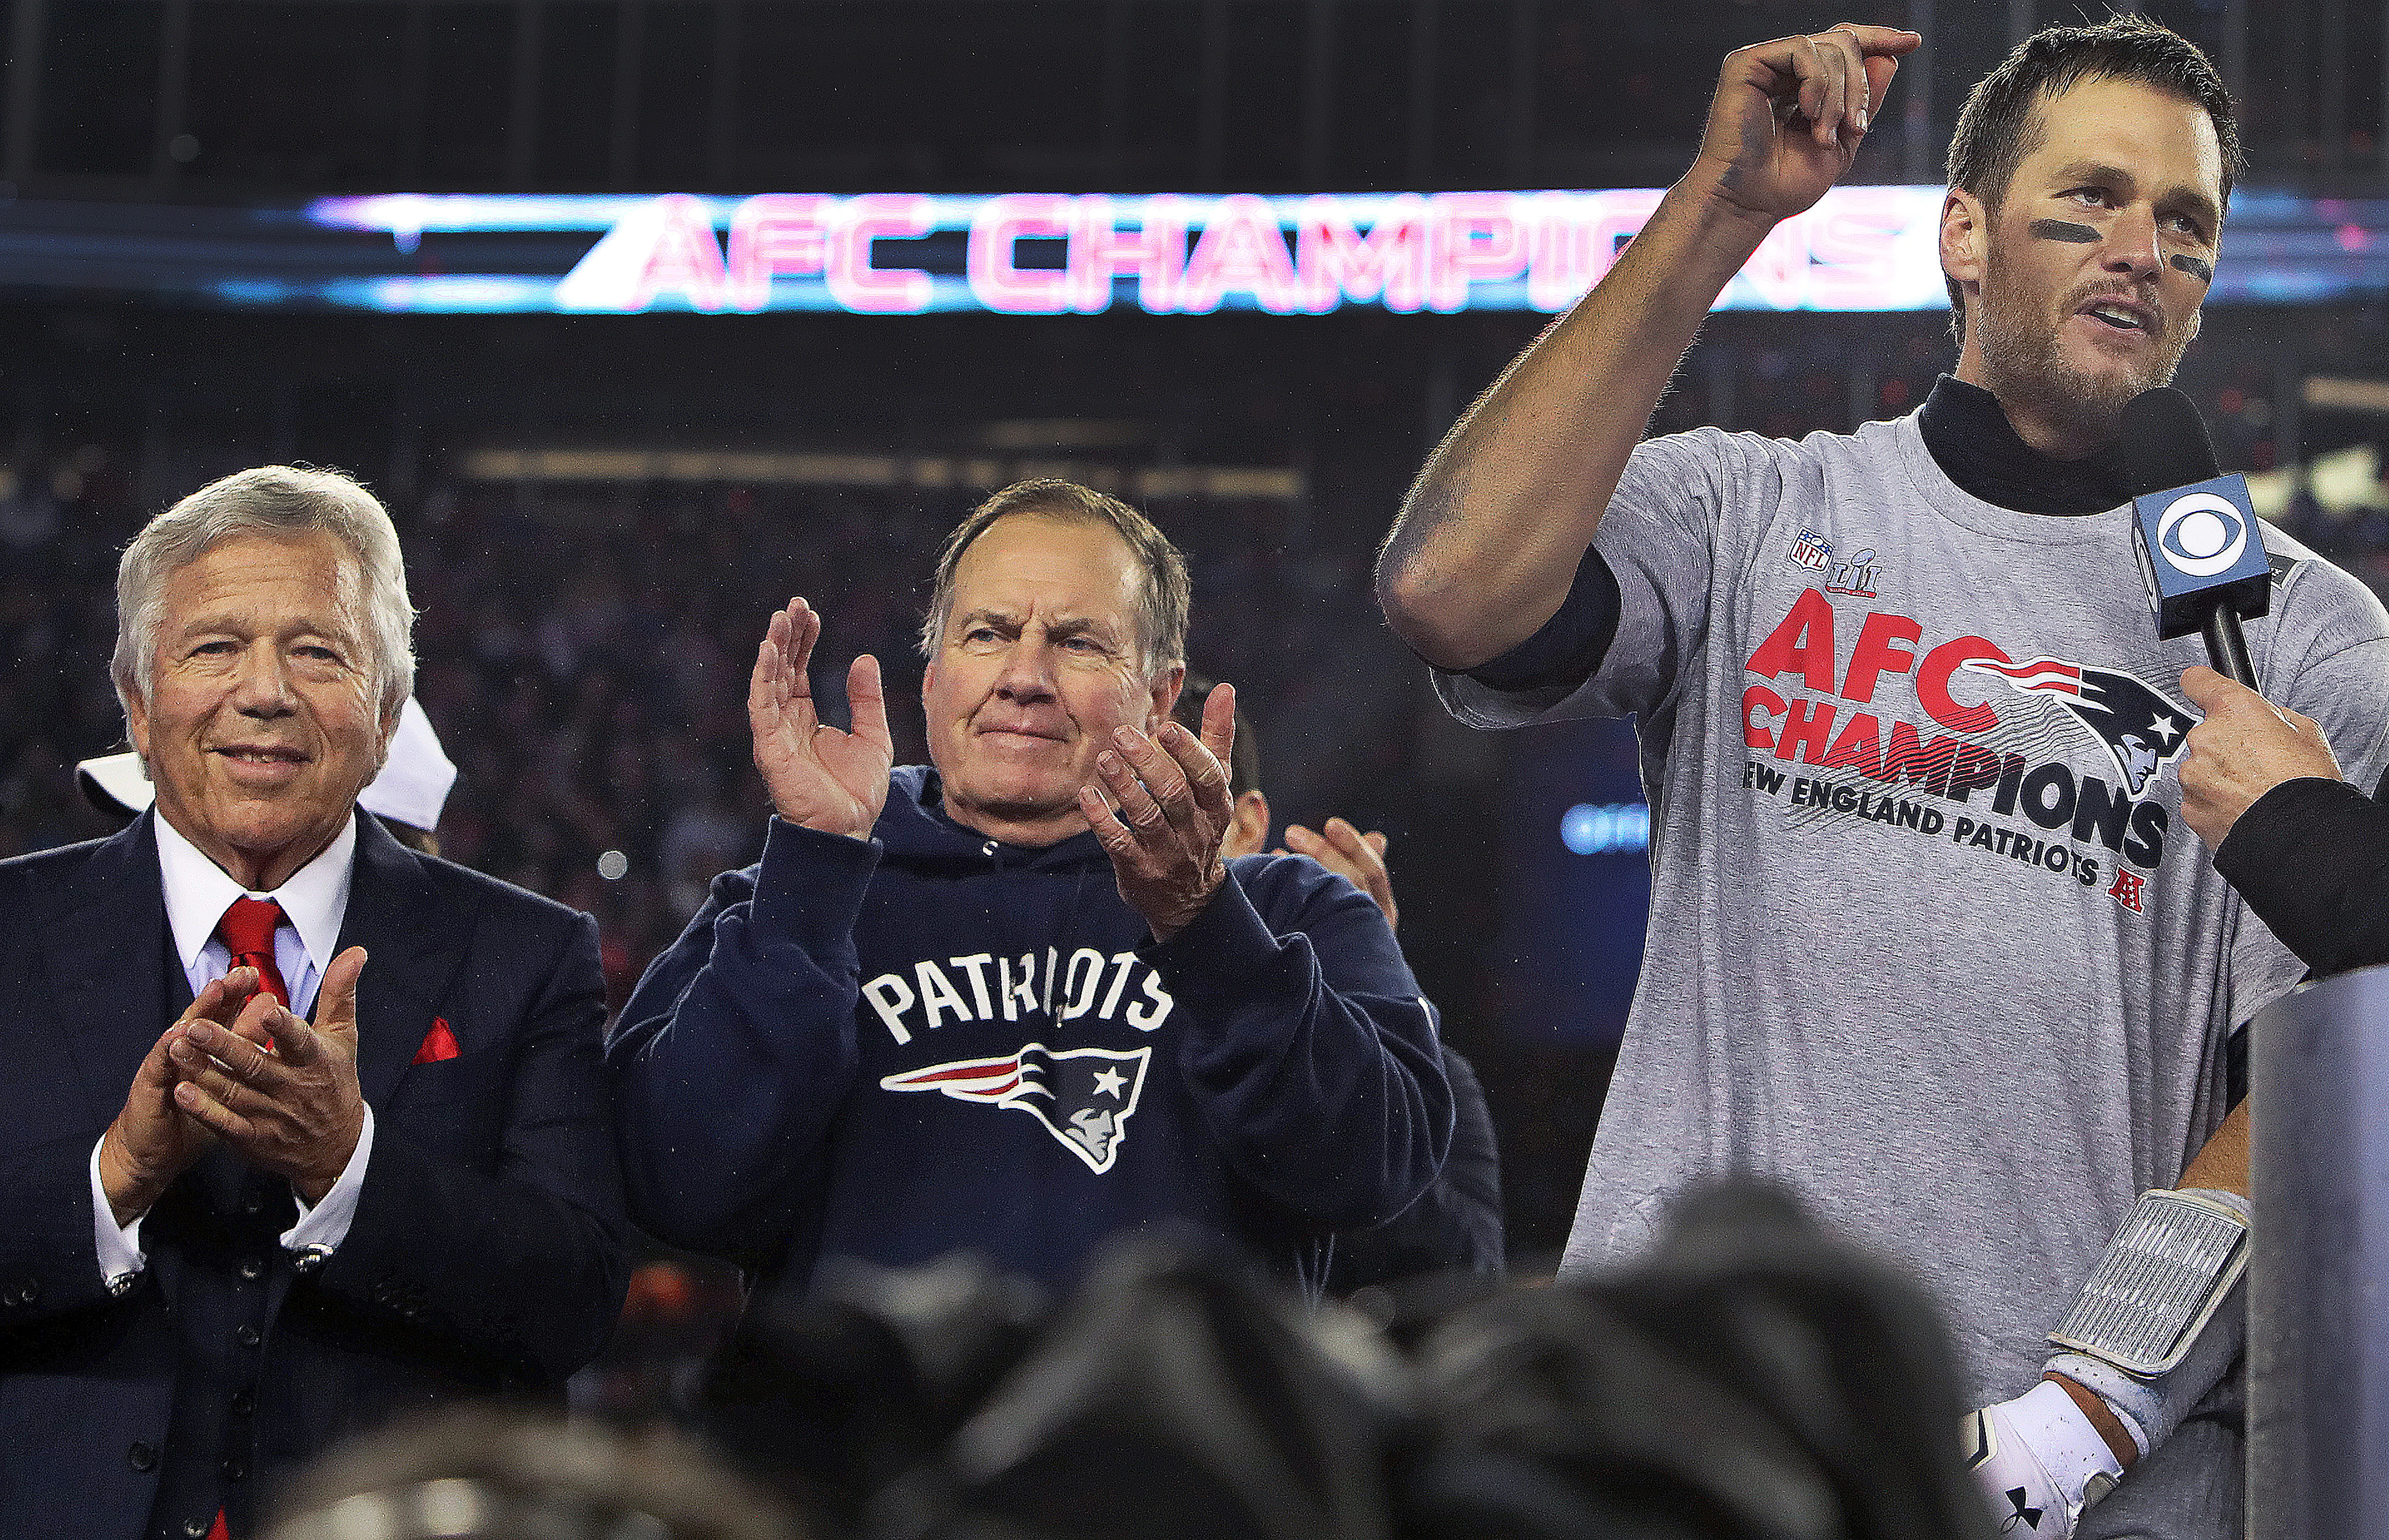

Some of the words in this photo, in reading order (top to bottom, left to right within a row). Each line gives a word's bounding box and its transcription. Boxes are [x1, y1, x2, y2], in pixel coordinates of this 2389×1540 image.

[624, 193, 937, 314] AFC
[1793, 541, 1824, 568] NFL
[1744, 587, 2013, 733] AFC
[1742, 685, 2169, 869] CHAMPIONS
[1742, 761, 1787, 796] EW
[1791, 777, 1944, 835] ENGLAND
[1953, 816, 2100, 886] PATRIOTS
[861, 945, 1175, 1046] PATRIOTS
